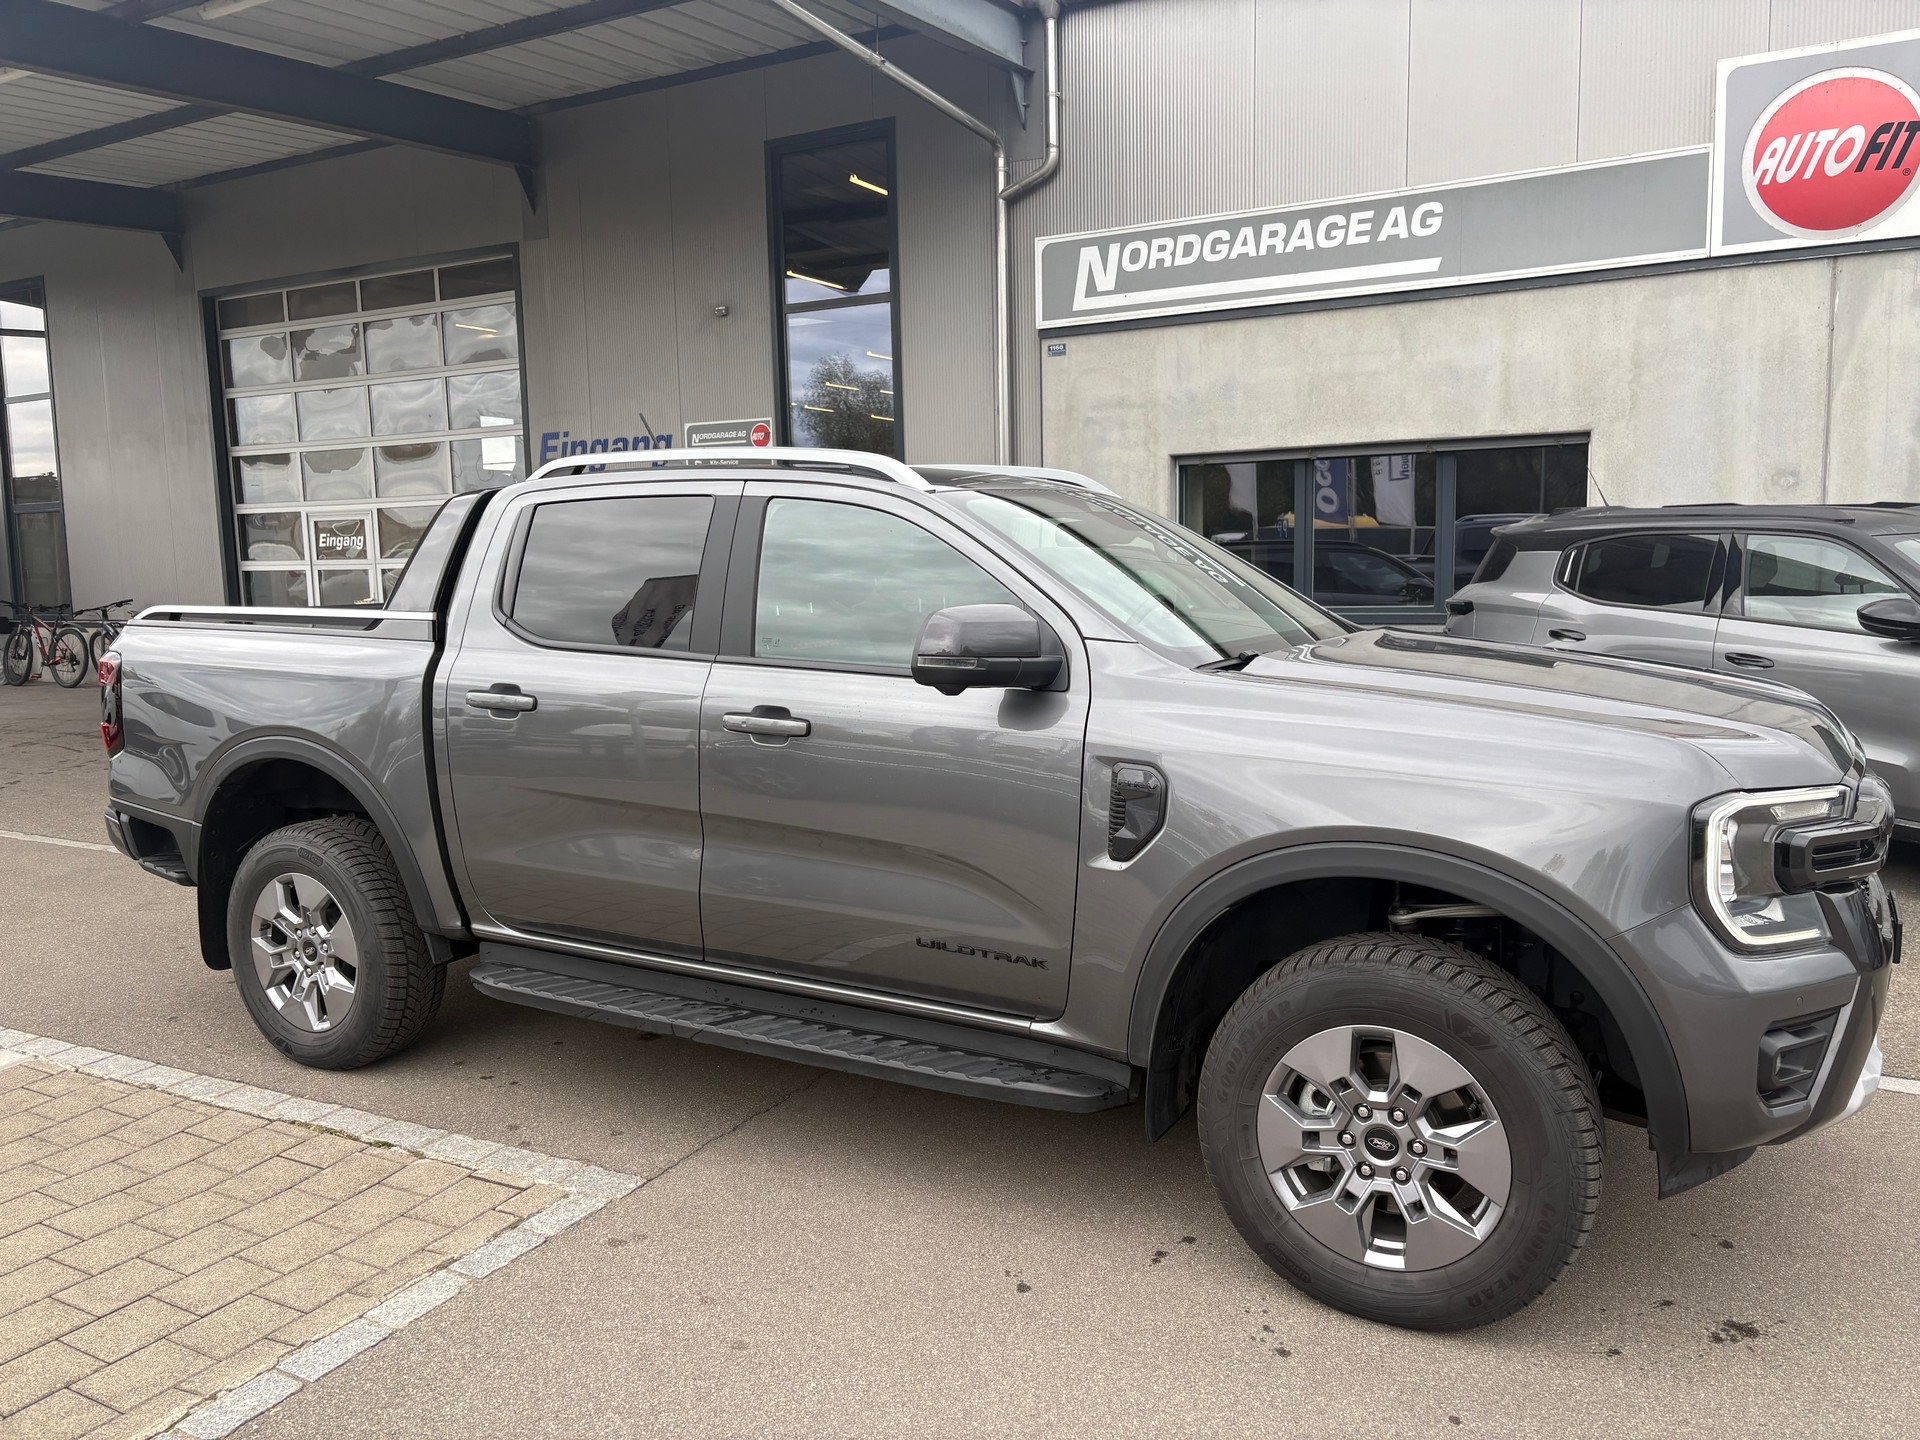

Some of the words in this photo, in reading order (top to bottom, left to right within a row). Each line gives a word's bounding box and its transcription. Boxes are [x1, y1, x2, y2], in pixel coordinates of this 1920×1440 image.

[1752, 120, 1920, 186] AUTOFIT
[1073, 210, 1375, 300] NORDGARAGE
[1377, 201, 1444, 242] AG
[692, 431, 736, 444] NORDGARAGE
[319, 533, 363, 550] Eingang
[916, 936, 1049, 971] WILDTRAK
